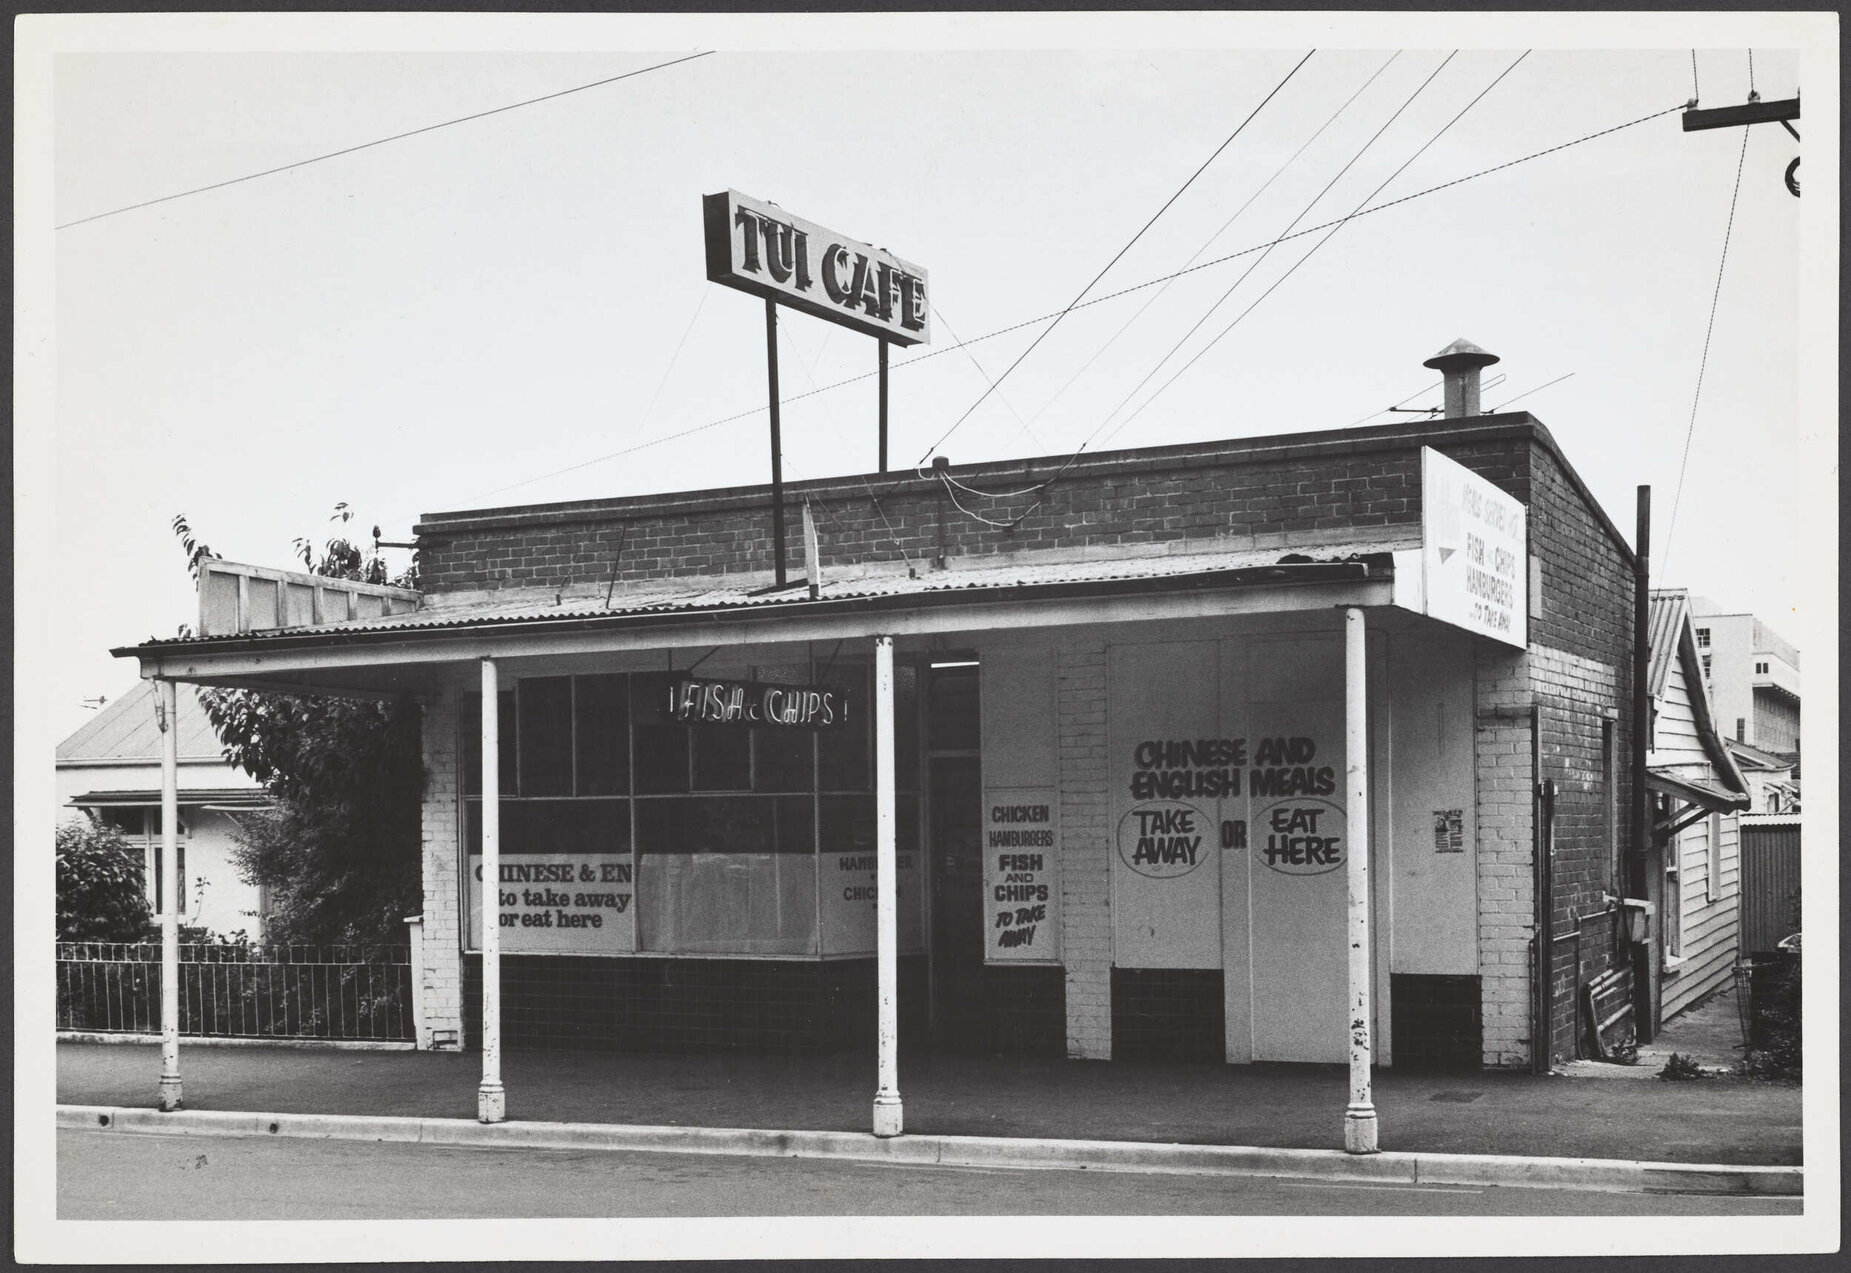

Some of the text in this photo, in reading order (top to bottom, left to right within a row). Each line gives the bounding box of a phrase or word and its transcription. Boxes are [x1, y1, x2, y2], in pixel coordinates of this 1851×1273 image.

[735, 204, 926, 332] TUI CAFE
[1466, 532, 1515, 580] FISH CHIPS
[1466, 565, 1514, 610] HAMBURGERS
[679, 682, 744, 722] FISH
[764, 687, 834, 724] CHIPS
[1134, 737, 1316, 770] CHINESE AND
[1130, 766, 1336, 800] ENGLISH MEALS
[992, 805, 1049, 823] CHICKEN
[1132, 809, 1194, 836] TAKE
[1269, 808, 1325, 834] EAT
[989, 830, 1053, 847] HAMBURGERS
[1221, 820, 1247, 849] OR
[1132, 836, 1202, 866] AWAY
[1263, 834, 1341, 865] HERE
[579, 863, 596, 882] &
[601, 864, 632, 882] EN
[839, 855, 913, 871] HAMBER
[999, 854, 1043, 871] FISH
[1005, 873, 1034, 883] AND
[499, 888, 632, 912] to take away
[994, 885, 1049, 902] CHIPS
[499, 909, 602, 928] or eat here
[995, 904, 1046, 928] TO TAKE
[998, 925, 1036, 948] AWAY
